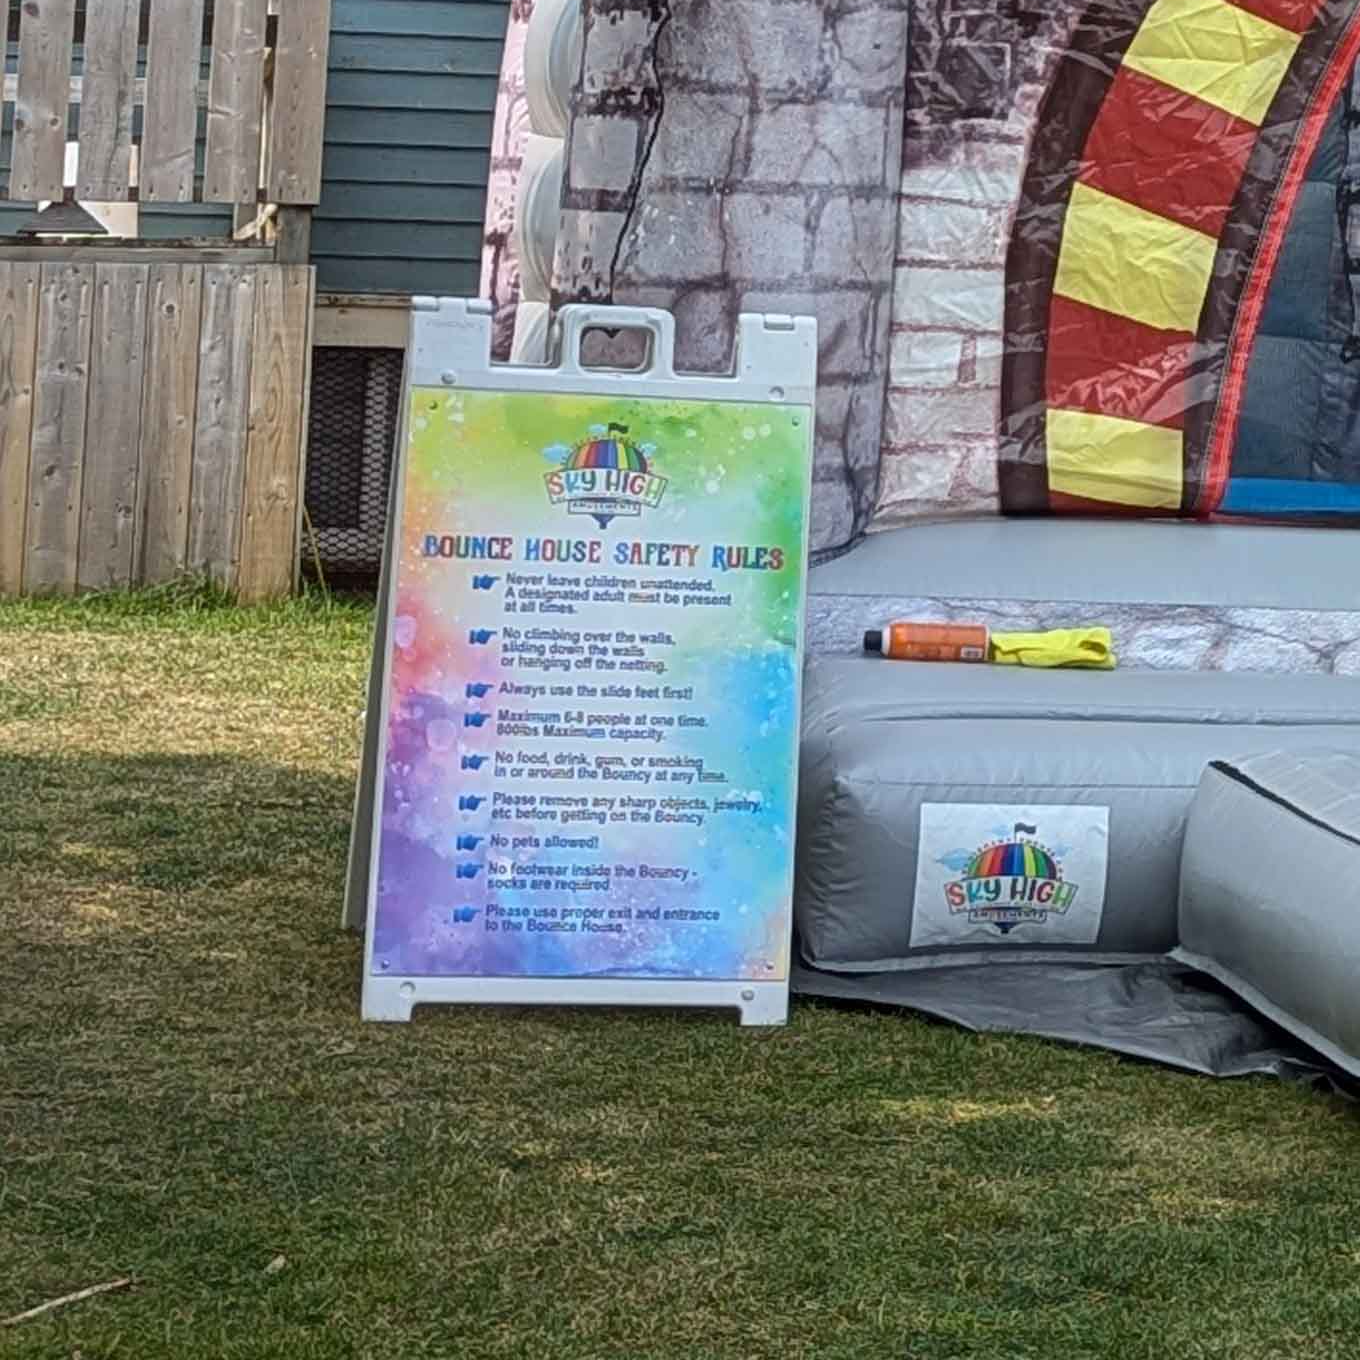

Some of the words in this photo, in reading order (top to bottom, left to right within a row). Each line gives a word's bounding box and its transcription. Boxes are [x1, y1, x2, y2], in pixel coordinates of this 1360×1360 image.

[549, 471, 595, 497] SKY
[605, 469, 663, 501] HIGH
[423, 535, 513, 560] BOUNCE
[525, 538, 602, 563] HOUSE
[613, 541, 699, 567] SAFETY
[711, 545, 784, 571] RULES
[506, 572, 544, 586] Never
[547, 574, 580, 587] leave
[584, 575, 636, 589] children
[640, 577, 716, 591] unattended.
[504, 588, 515, 599] A
[518, 589, 590, 603] designated
[593, 591, 625, 603] adult
[628, 592, 660, 604] must
[664, 593, 680, 605] be
[683, 594, 732, 607] present
[504, 602, 517, 613] at
[520, 602, 536, 613] all
[539, 603, 577, 615] times.
[502, 627, 521, 639] No
[524, 628, 580, 643] climbing
[583, 631, 612, 642] over
[615, 631, 635, 643] the
[502, 641, 547, 656] sliding
[550, 642, 585, 654] down
[588, 644, 608, 655] the
[612, 645, 646, 657] walls
[501, 657, 514, 667] or
[518, 656, 571, 671] hanging
[574, 658, 593, 669] off
[596, 659, 616, 670] the
[499, 681, 547, 698] Always
[550, 685, 574, 696] use
[577, 685, 597, 697] the
[601, 685, 632, 698] slide
[635, 685, 659, 698] feet
[498, 709, 561, 722] Maximum
[587, 713, 631, 726] people
[634, 714, 647, 725] at
[650, 716, 675, 727] one
[543, 724, 605, 737] Maximum
[495, 751, 514, 763] No
[517, 751, 550, 766] food,
[630, 757, 645, 767] or
[648, 756, 704, 771] smoking
[494, 767, 506, 777] in
[510, 767, 524, 778] or
[528, 766, 575, 779] around
[577, 766, 598, 779] the
[602, 767, 652, 784] Bouncy
[654, 770, 668, 781] at
[671, 772, 695, 784] any
[493, 792, 537, 805] Please
[540, 796, 589, 807] remove
[592, 798, 616, 810] any
[620, 796, 656, 810] sharp
[491, 808, 512, 819] etc
[515, 808, 558, 820] before
[560, 809, 607, 824] getting
[630, 810, 651, 822] the
[489, 834, 509, 847] No
[511, 835, 540, 849] pets
[488, 862, 508, 874] No
[510, 862, 569, 876] footwear
[571, 864, 611, 877] inside
[615, 865, 636, 877] the
[639, 864, 689, 881] Bouncy
[487, 878, 528, 890] socks
[530, 880, 552, 890] are
[949, 879, 1000, 907] SKY
[1010, 878, 1073, 908] HIGH
[486, 904, 530, 917] Please
[533, 908, 558, 918] use
[561, 908, 604, 921] proper
[607, 906, 632, 919] exit
[635, 907, 661, 920] and
[663, 909, 721, 921] entrance
[485, 920, 498, 931] to
[501, 920, 523, 931] the
[526, 918, 578, 932] Bounce
